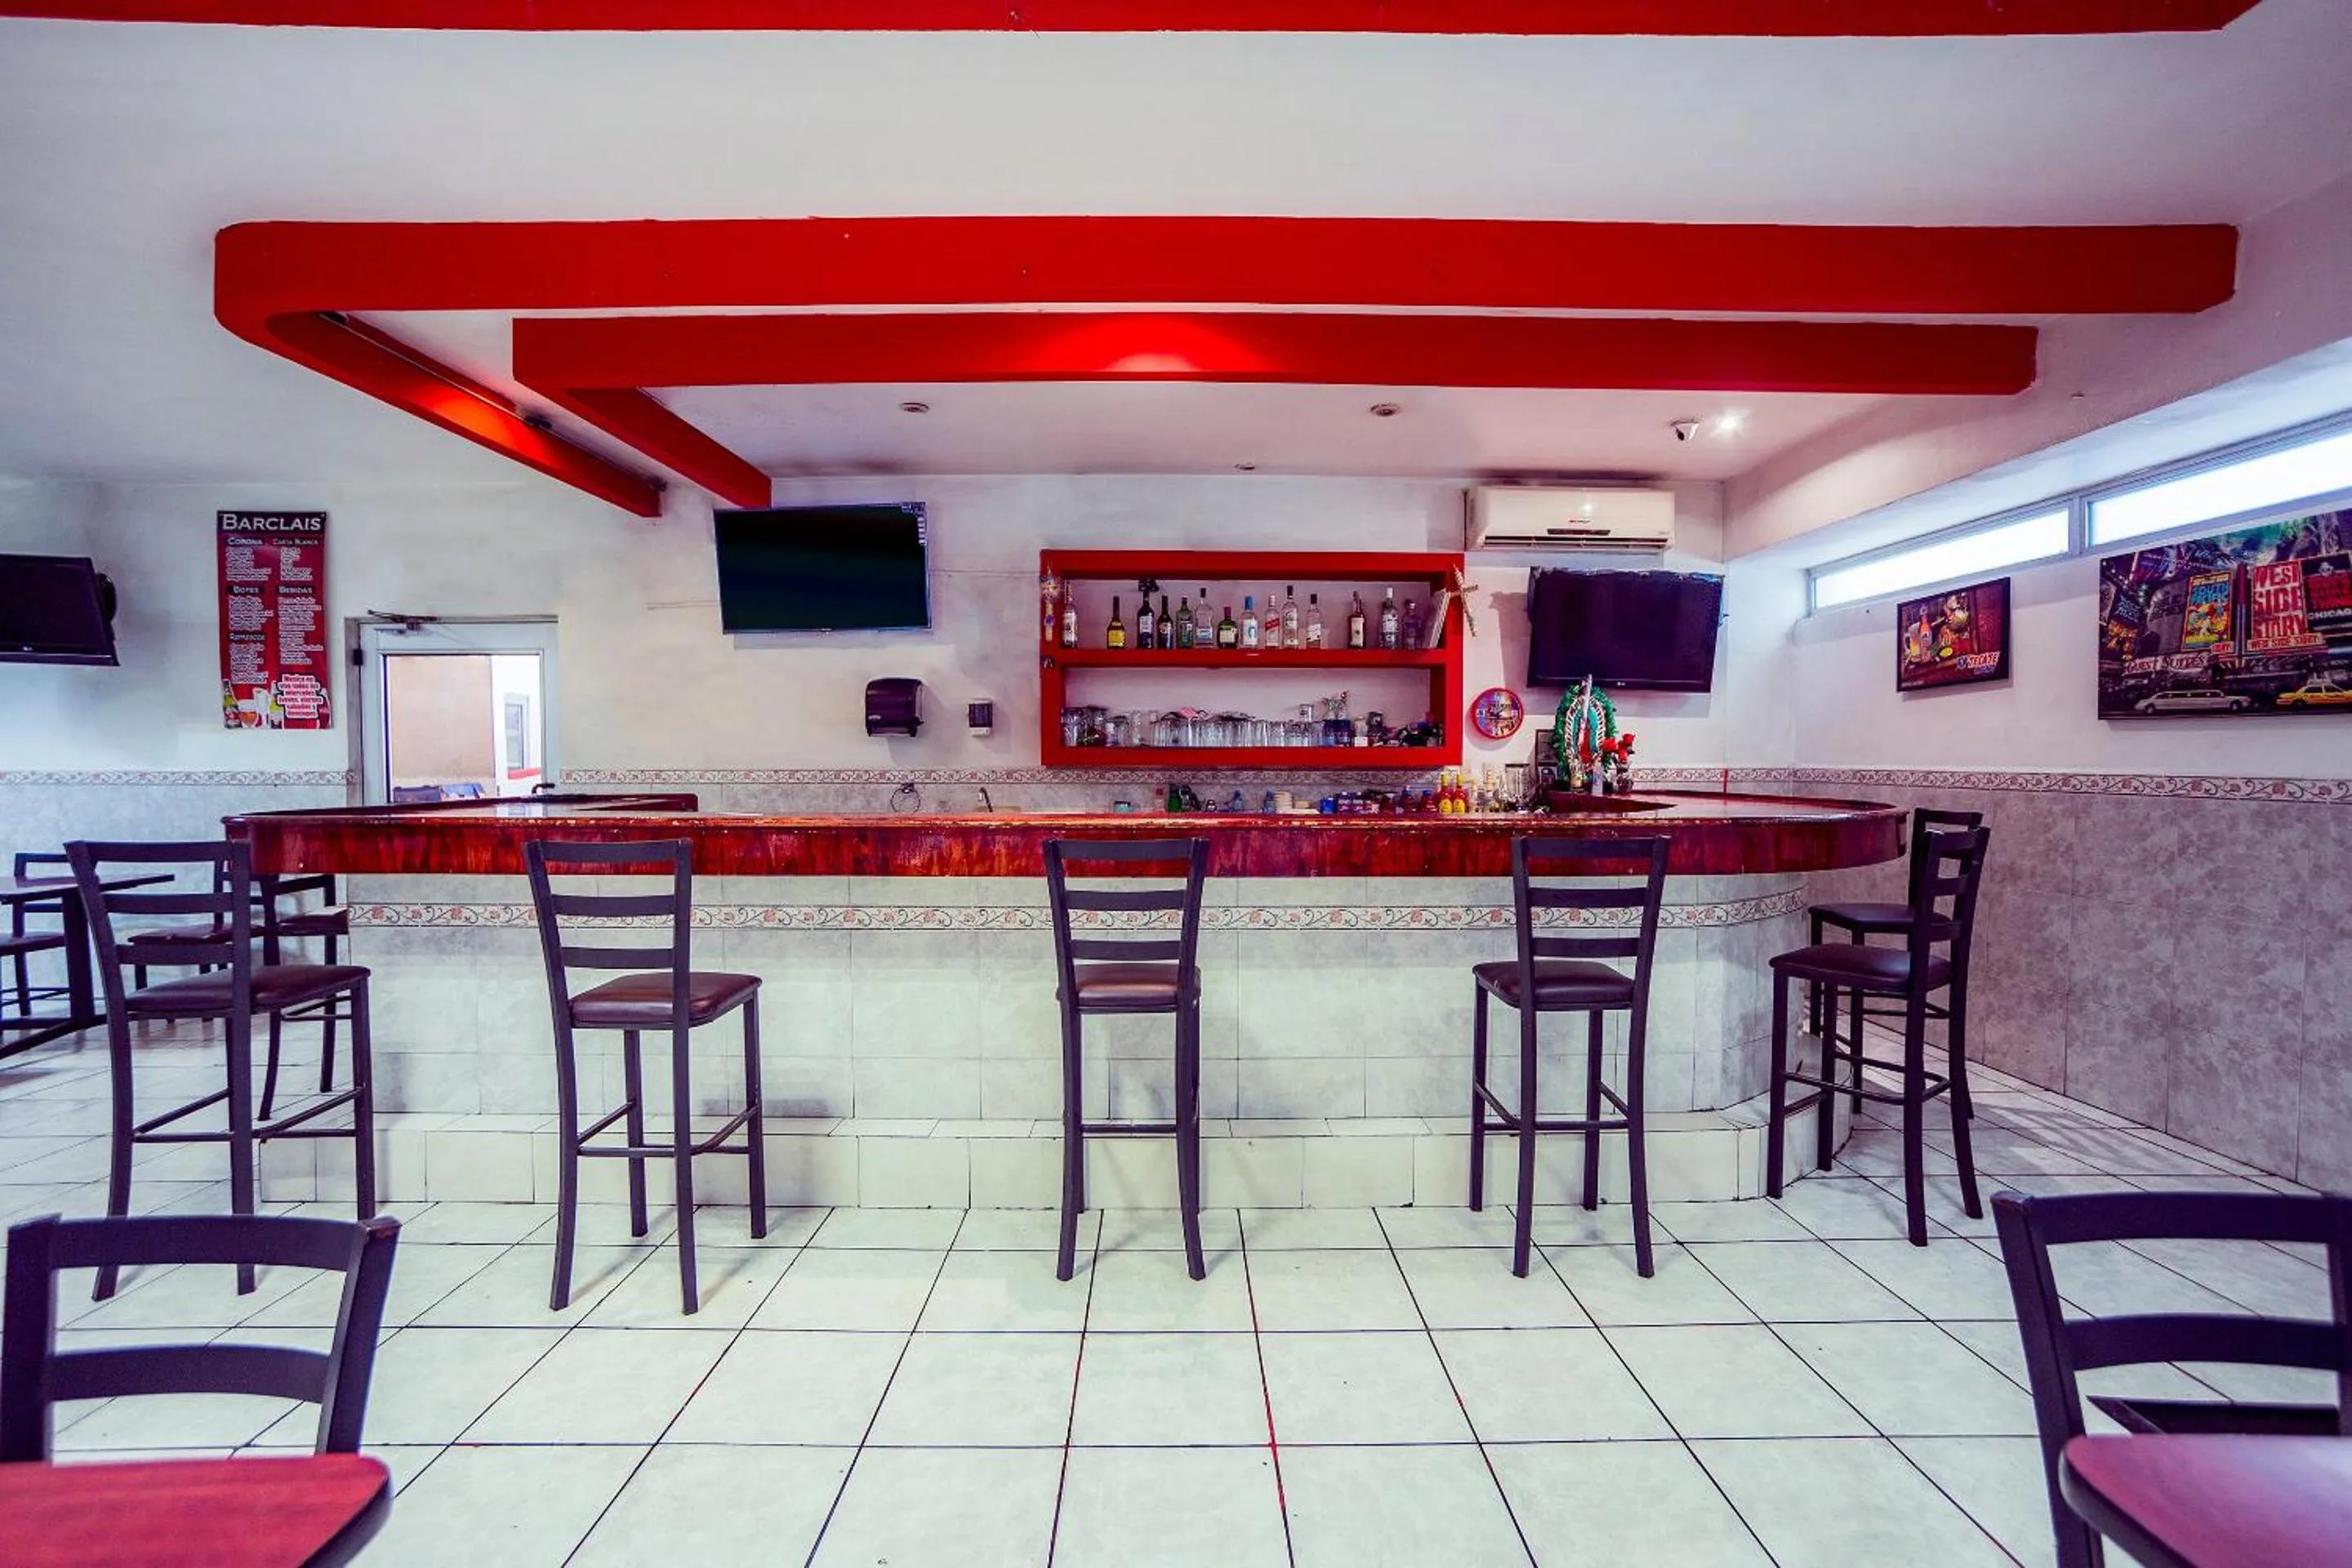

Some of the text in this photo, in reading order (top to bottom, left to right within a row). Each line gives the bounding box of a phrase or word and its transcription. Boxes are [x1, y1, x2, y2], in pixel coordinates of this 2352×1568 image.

[2255, 562, 2299, 586] WEST
[2254, 585, 2302, 614] SIDE
[2253, 614, 2306, 639] STORY
